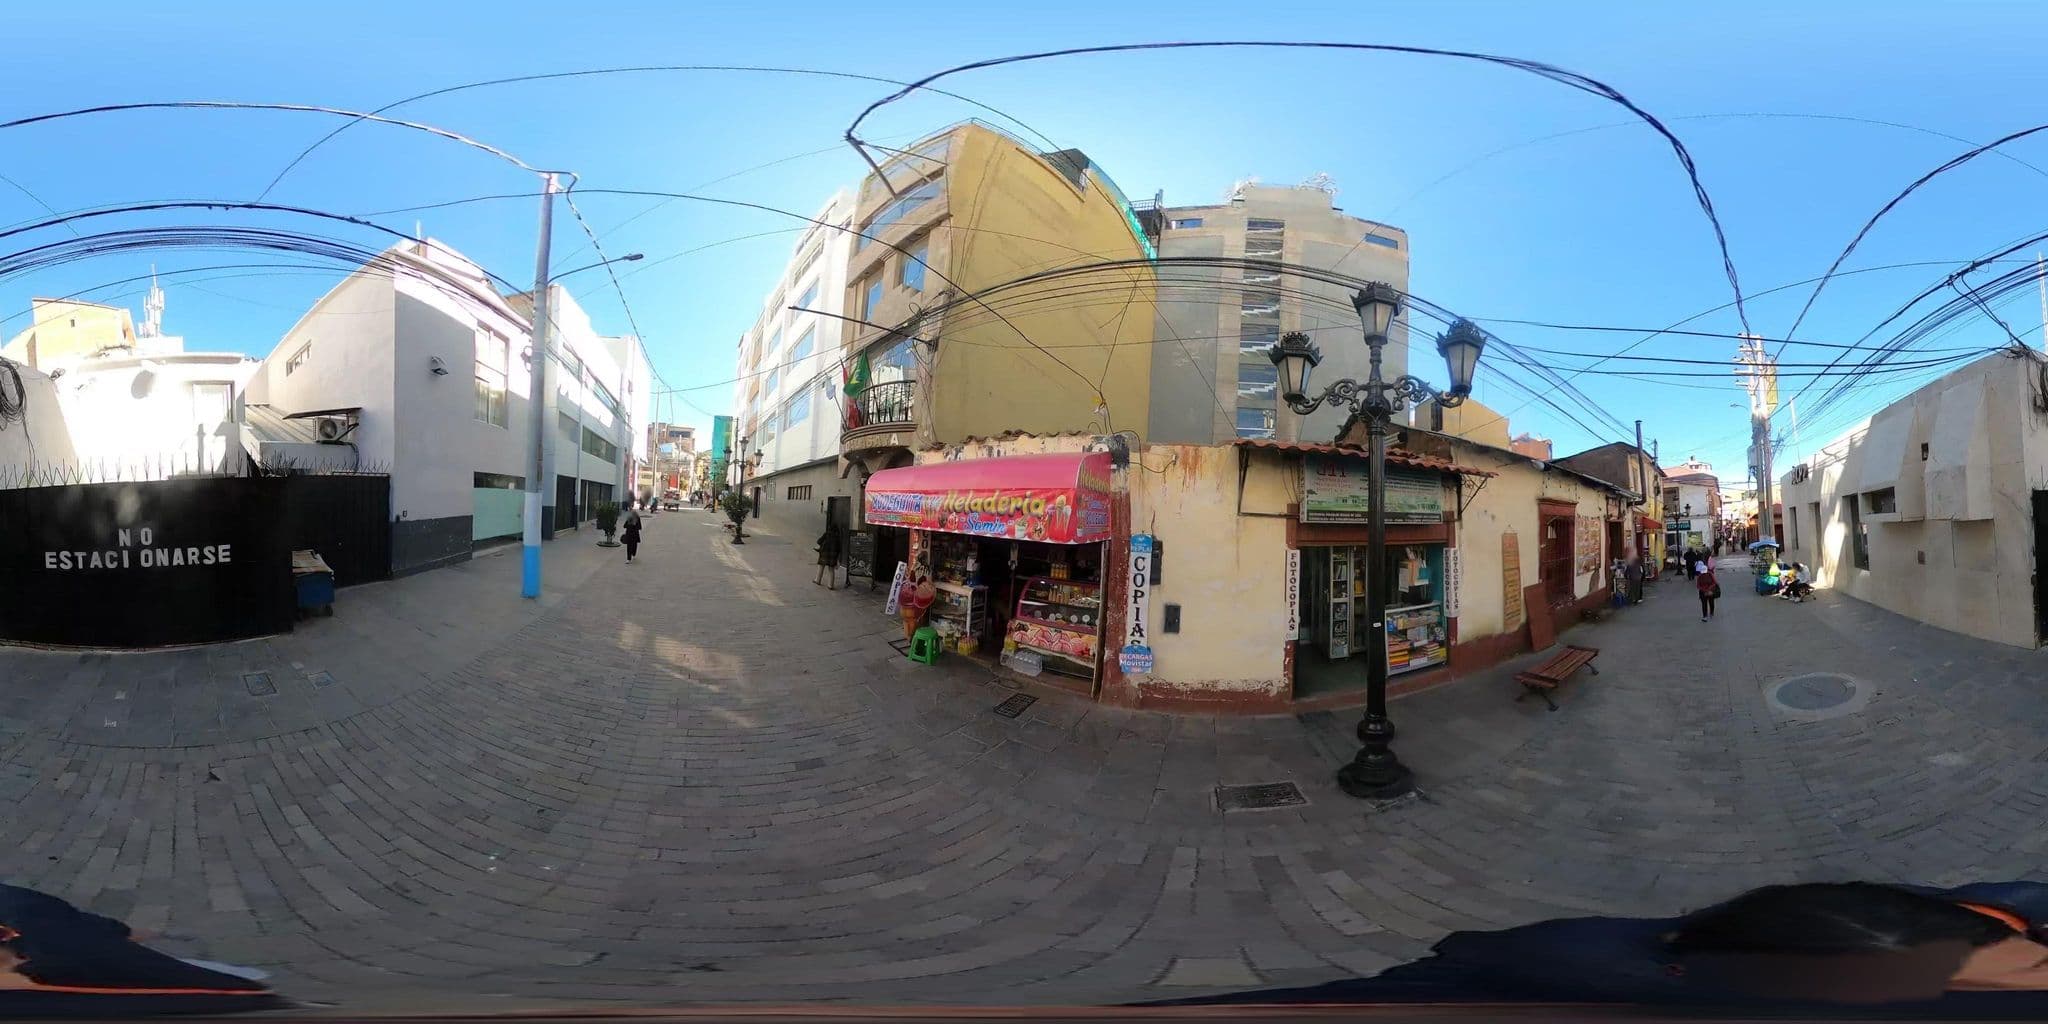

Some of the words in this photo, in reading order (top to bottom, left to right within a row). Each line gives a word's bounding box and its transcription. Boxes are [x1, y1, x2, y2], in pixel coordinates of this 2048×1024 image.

[118, 527, 153, 547] NO
[886, 563, 906, 613] COPIAS
[1288, 552, 1297, 632] FOTOCOPIAS
[1119, 659, 1153, 668] Movistar
